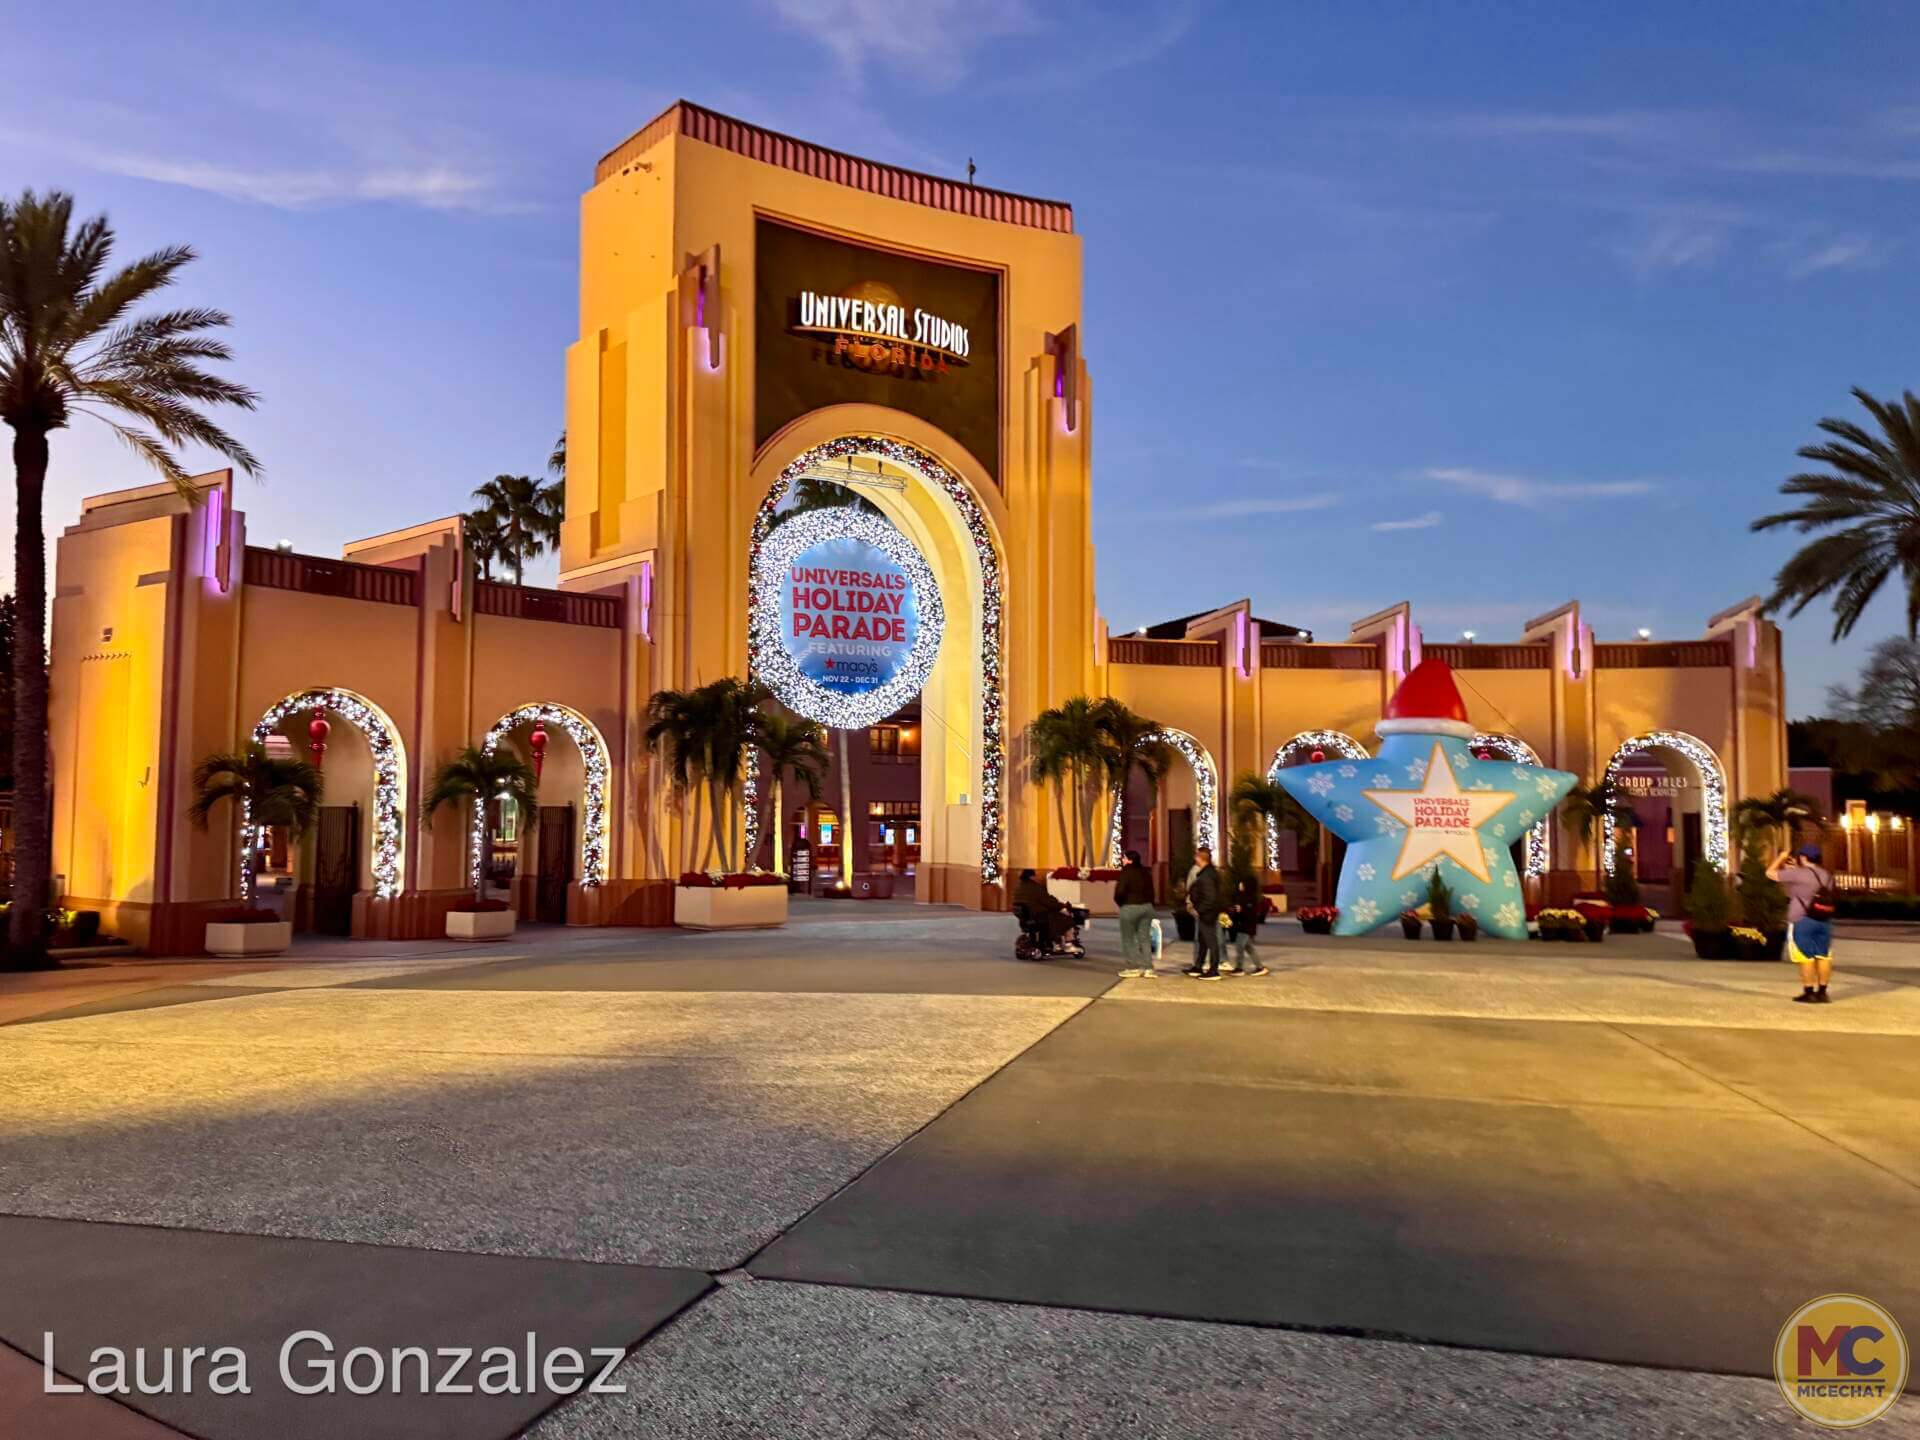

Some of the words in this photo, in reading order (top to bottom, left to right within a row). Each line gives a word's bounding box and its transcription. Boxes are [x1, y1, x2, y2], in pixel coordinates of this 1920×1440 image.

[800, 291, 908, 339] UNIVERSAL
[913, 308, 970, 357] STUDIOS
[835, 337, 950, 375] FLORIDA
[791, 567, 906, 590] UNIVERSAL'S
[792, 587, 905, 615] HOLIDAY
[793, 612, 906, 643] PARADE
[808, 642, 892, 657] FEATURING
[836, 658, 879, 675] macy's
[822, 675, 839, 683] NOV
[840, 675, 850, 683] 22
[855, 676, 870, 684] DEC
[1415, 806, 1469, 817] HOLIDAY
[1415, 816, 1471, 828] PARADE
